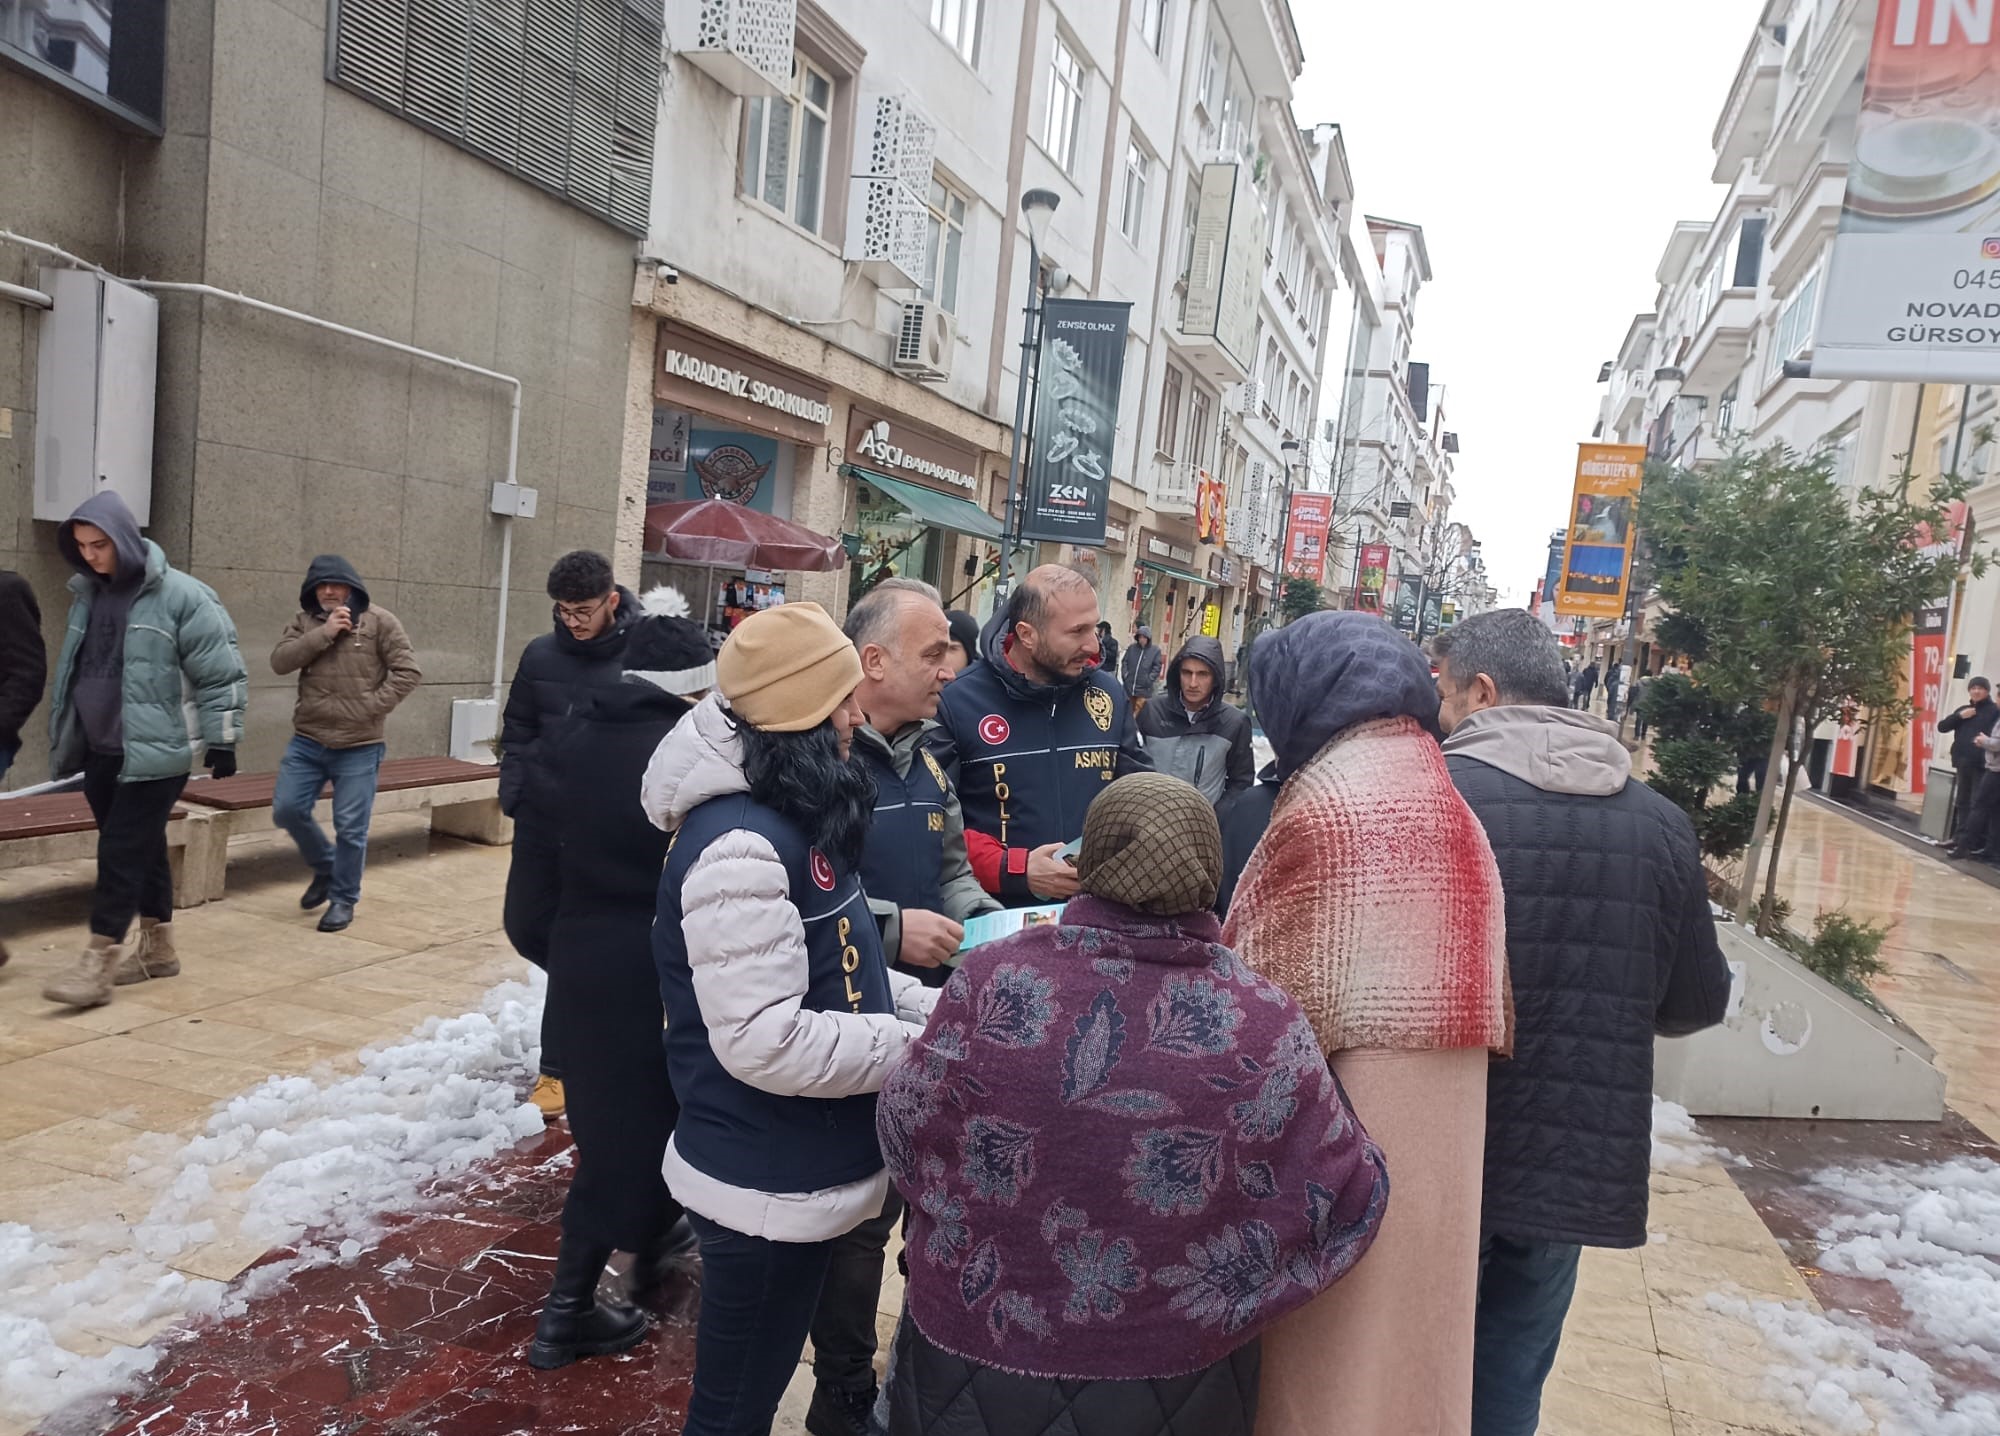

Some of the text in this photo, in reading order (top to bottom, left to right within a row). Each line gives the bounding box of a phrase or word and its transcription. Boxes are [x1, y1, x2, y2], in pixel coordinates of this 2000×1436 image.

[1087, 322, 1116, 332] OLMAZ
[665, 349, 833, 426] KARADENİZ SPOR KULÜBÜ
[1049, 483, 1088, 500] ZEN
[993, 763, 1011, 848] POLİ
